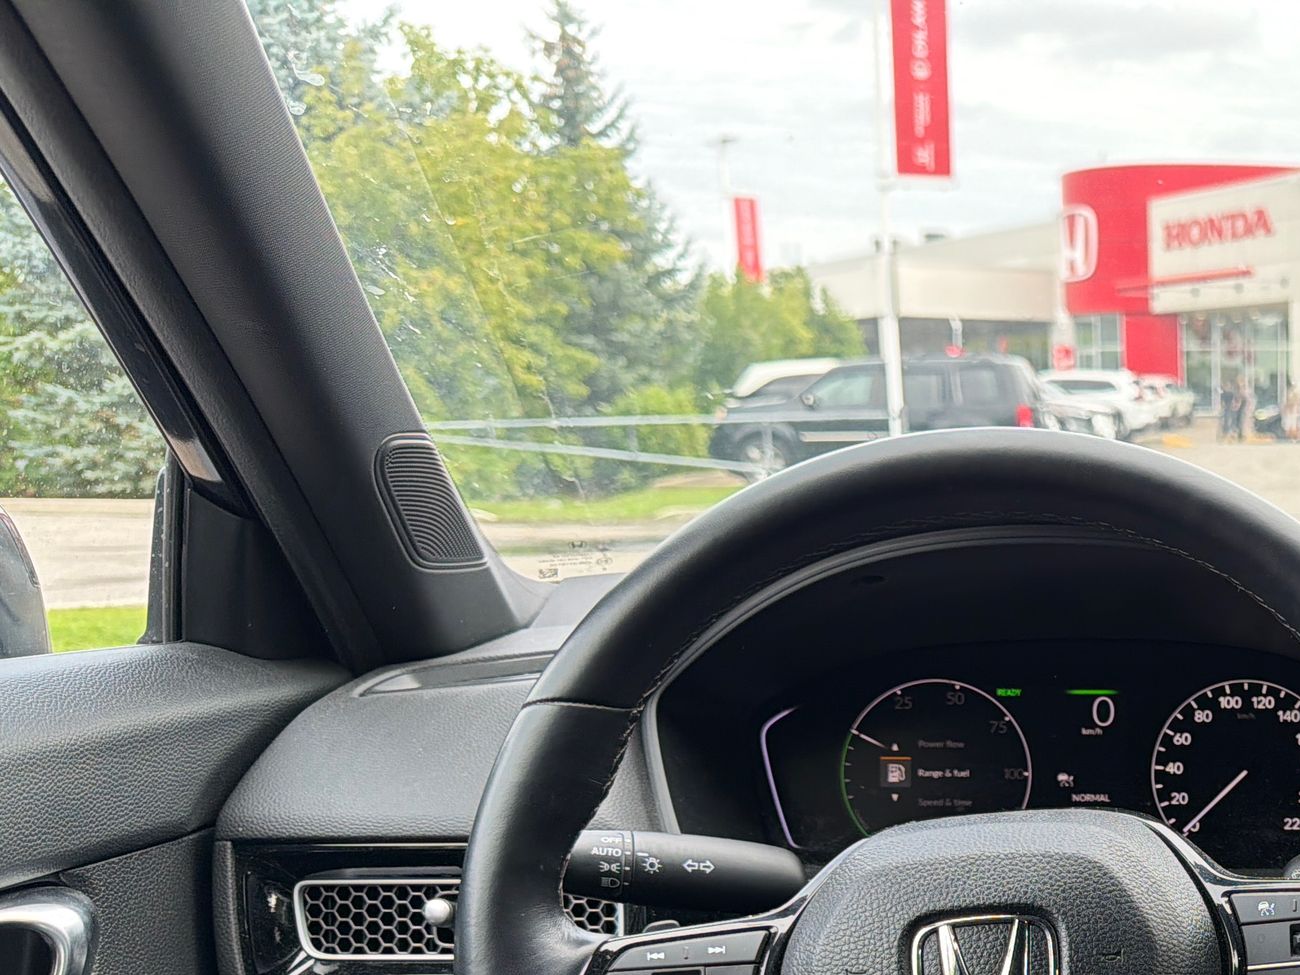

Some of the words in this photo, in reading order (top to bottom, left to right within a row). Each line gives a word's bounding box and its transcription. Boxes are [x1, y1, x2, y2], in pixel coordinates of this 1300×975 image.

[1163, 208, 1274, 250] HONDA
[947, 691, 966, 705] 50
[996, 687, 1022, 697] READY
[894, 697, 913, 710] 25
[1218, 696, 1242, 709] 100
[1251, 696, 1275, 709] 120
[1092, 696, 1115, 727] 0
[1193, 709, 1213, 723] 80
[1277, 709, 1300, 723] 140
[989, 720, 1008, 734] 75
[1081, 727, 1103, 736] km/h
[1172, 732, 1192, 746] 60
[917, 768, 944, 779] Range
[953, 769, 970, 777] fuel
[1003, 768, 1025, 780] 100
[1165, 761, 1184, 775] 40
[1071, 793, 1111, 803] NORMAL
[1170, 791, 1189, 805] 20
[600, 836, 623, 844] OFF
[591, 847, 622, 857] AUTO
